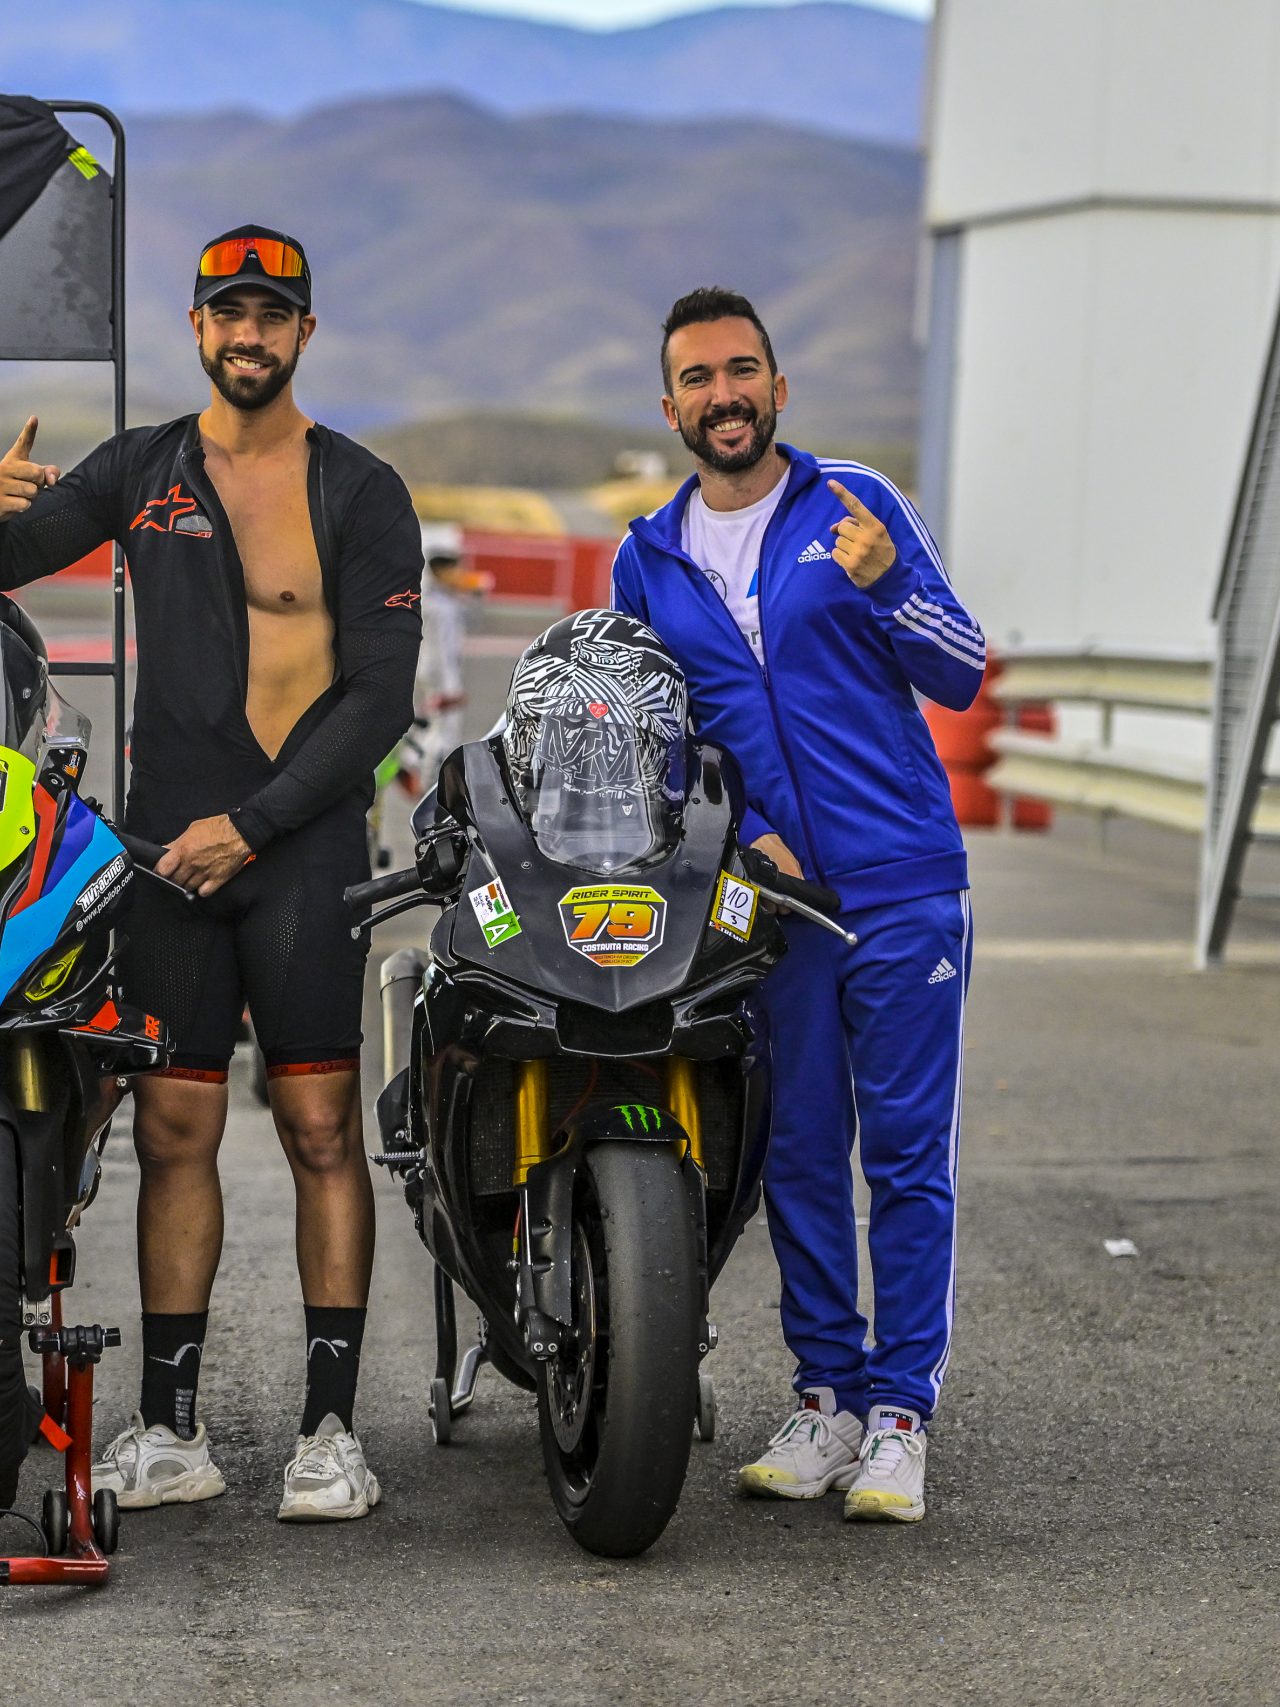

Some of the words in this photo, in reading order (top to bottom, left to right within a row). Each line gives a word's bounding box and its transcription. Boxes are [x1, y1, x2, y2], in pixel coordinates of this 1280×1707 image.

[797, 552, 832, 563] adidas
[571, 890, 609, 900] RIDER
[612, 889, 652, 899] SPIRIT
[570, 903, 658, 943] 79
[730, 915, 738, 925] 3
[485, 923, 510, 943] A
[927, 968, 957, 984] adidas
[145, 1014, 160, 1042] RR
[881, 1412, 913, 1422] TOMMY
